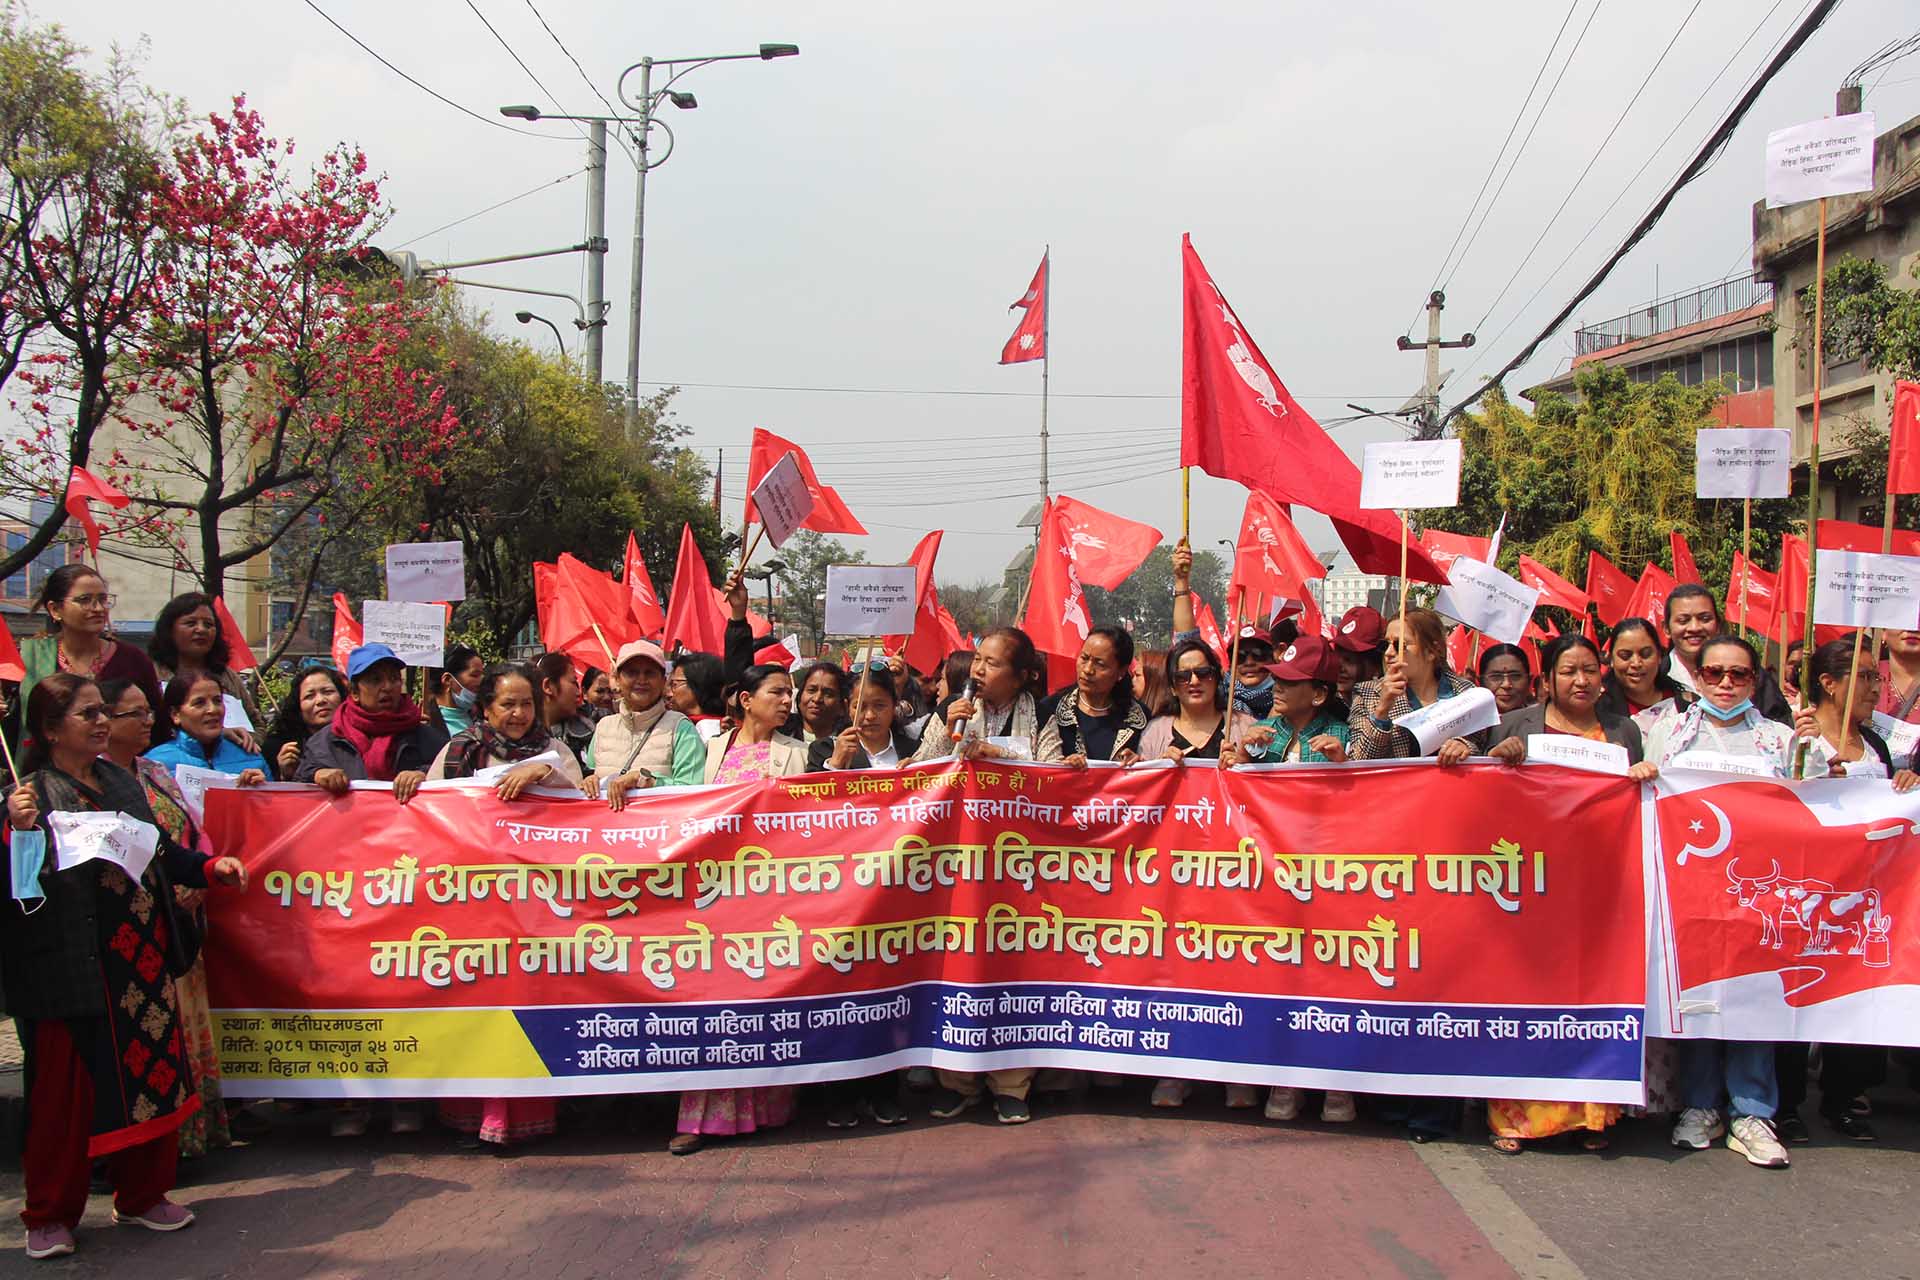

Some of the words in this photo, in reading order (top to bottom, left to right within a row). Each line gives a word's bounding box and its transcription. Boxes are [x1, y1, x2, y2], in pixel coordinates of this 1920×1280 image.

[846, 775, 895, 794] श्रमिक
[976, 771, 1002, 790] एक
[601, 820, 668, 849] सम्पूर्ण
[753, 805, 881, 838] समानुपातीक
[891, 797, 954, 827] महिला
[963, 795, 1063, 824] सहभागिता
[1072, 798, 1167, 831] सुनिश्चित
[264, 870, 354, 918] ११५
[425, 852, 688, 917] अन्तराष्ट्रिय
[694, 845, 844, 909] श्रमिक
[853, 833, 986, 893] महिला
[994, 831, 1117, 892] दिवस
[1171, 837, 1263, 890] मार्च)
[1274, 851, 1418, 901] सफल
[371, 925, 511, 987] महिला
[519, 922, 632, 975] माथि
[640, 920, 714, 989] हुने
[722, 915, 802, 979] सबै
[810, 914, 978, 973] खालका
[986, 902, 1166, 967] विभेदको
[1175, 920, 1304, 965] अन्त्य
[222, 1018, 265, 1033] स्थान:
[271, 1014, 384, 1033] माईतीघरमण्डला
[577, 1011, 640, 1039] अखिल
[645, 1011, 699, 1037] नेपाल
[704, 1009, 764, 1036] महिला
[769, 1008, 801, 1031] संघ
[808, 995, 911, 1030] (क्रान्तिकारी)
[942, 991, 995, 1019] अखिल
[999, 991, 1045, 1015] नेपाल
[1050, 990, 1106, 1018] महिला
[1111, 995, 1141, 1019] संघ
[1146, 999, 1243, 1027] (समाजवादी)
[1288, 1006, 1351, 1033] अखिल
[1356, 1009, 1410, 1037] नेपाल
[1416, 1012, 1480, 1040] महिला
[1486, 1014, 1519, 1040] संघ
[1525, 1013, 1639, 1041] क्रान्तिकारी
[221, 1036, 259, 1054] मिति:
[264, 1039, 304, 1055] २०८१
[309, 1039, 362, 1058] फाल्गुन
[368, 1040, 387, 1055] २४
[393, 1035, 419, 1054] गते
[942, 1021, 988, 1047] नेपाल
[992, 1020, 1074, 1046] समाजवादी
[1078, 1022, 1135, 1050] महिला
[1139, 1027, 1170, 1051] संघ
[222, 1060, 263, 1075] समय:
[364, 1058, 389, 1074] बजे
[577, 1042, 640, 1069] अखिल
[645, 1042, 700, 1067] नेपाल
[705, 1039, 765, 1065] महिला
[770, 1038, 802, 1060] संघ
